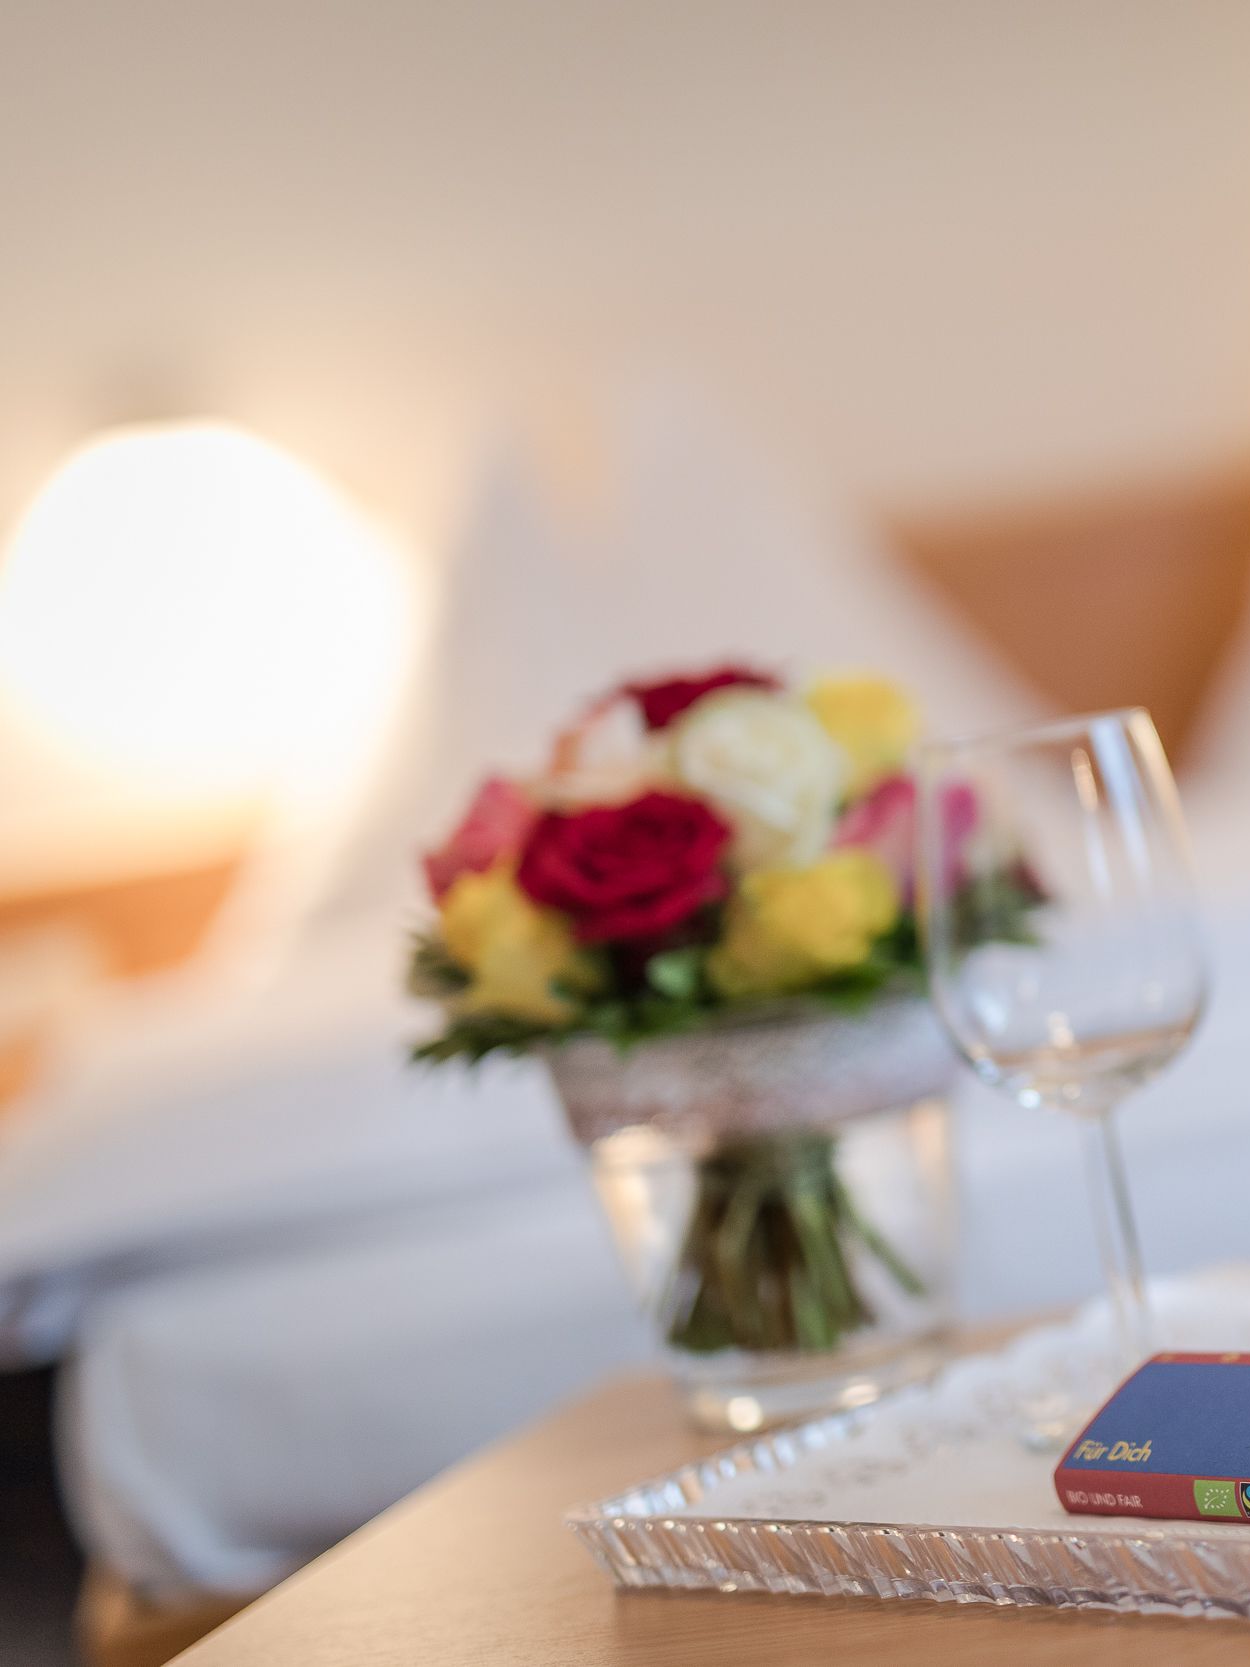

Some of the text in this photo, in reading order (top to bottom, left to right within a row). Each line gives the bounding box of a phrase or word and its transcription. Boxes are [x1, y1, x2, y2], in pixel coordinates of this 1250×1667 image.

[1073, 1439, 1153, 1462] Für Dich
[1066, 1490, 1144, 1509] BIO UND FAIR
